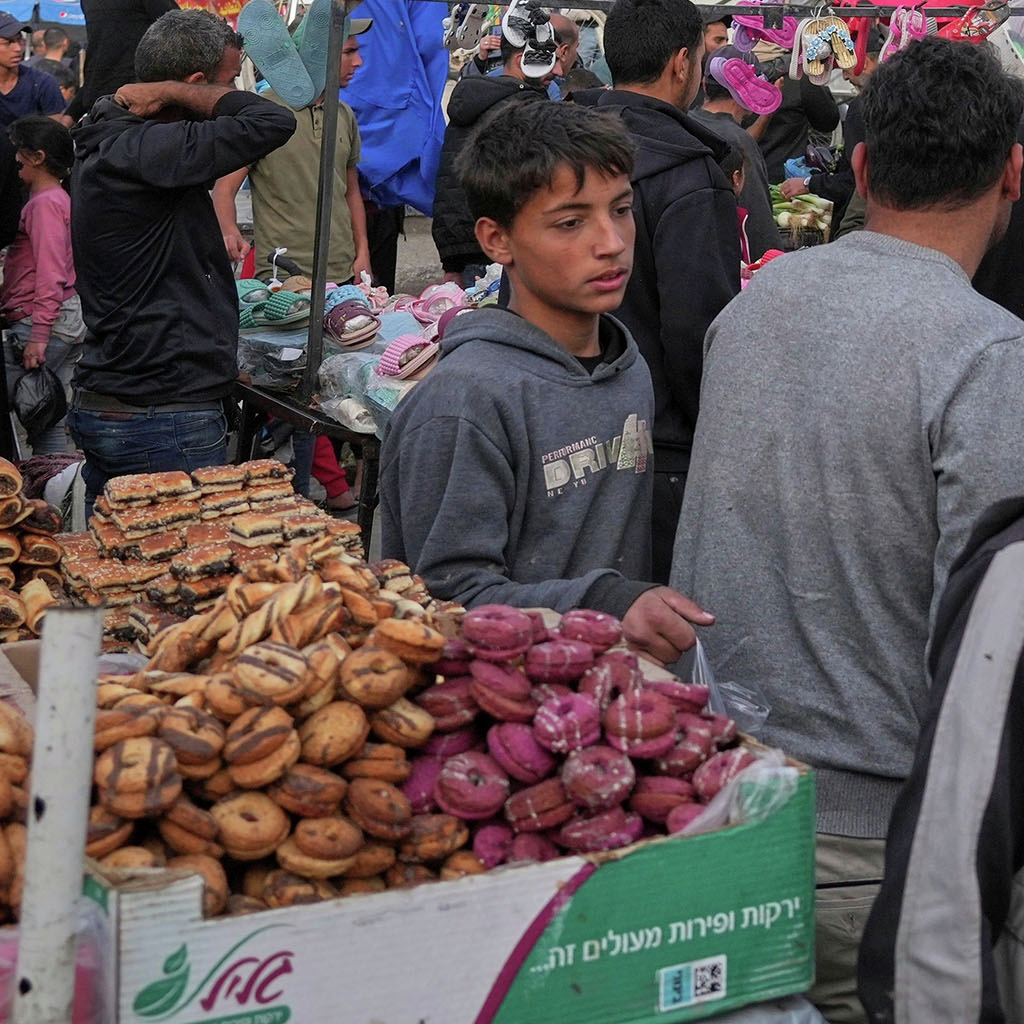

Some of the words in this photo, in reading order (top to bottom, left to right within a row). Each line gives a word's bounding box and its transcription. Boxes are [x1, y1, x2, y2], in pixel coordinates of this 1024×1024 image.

[667, 910, 735, 945] ופירות
[741, 896, 801, 928] ירקות
[582, 925, 662, 962] מעולים
